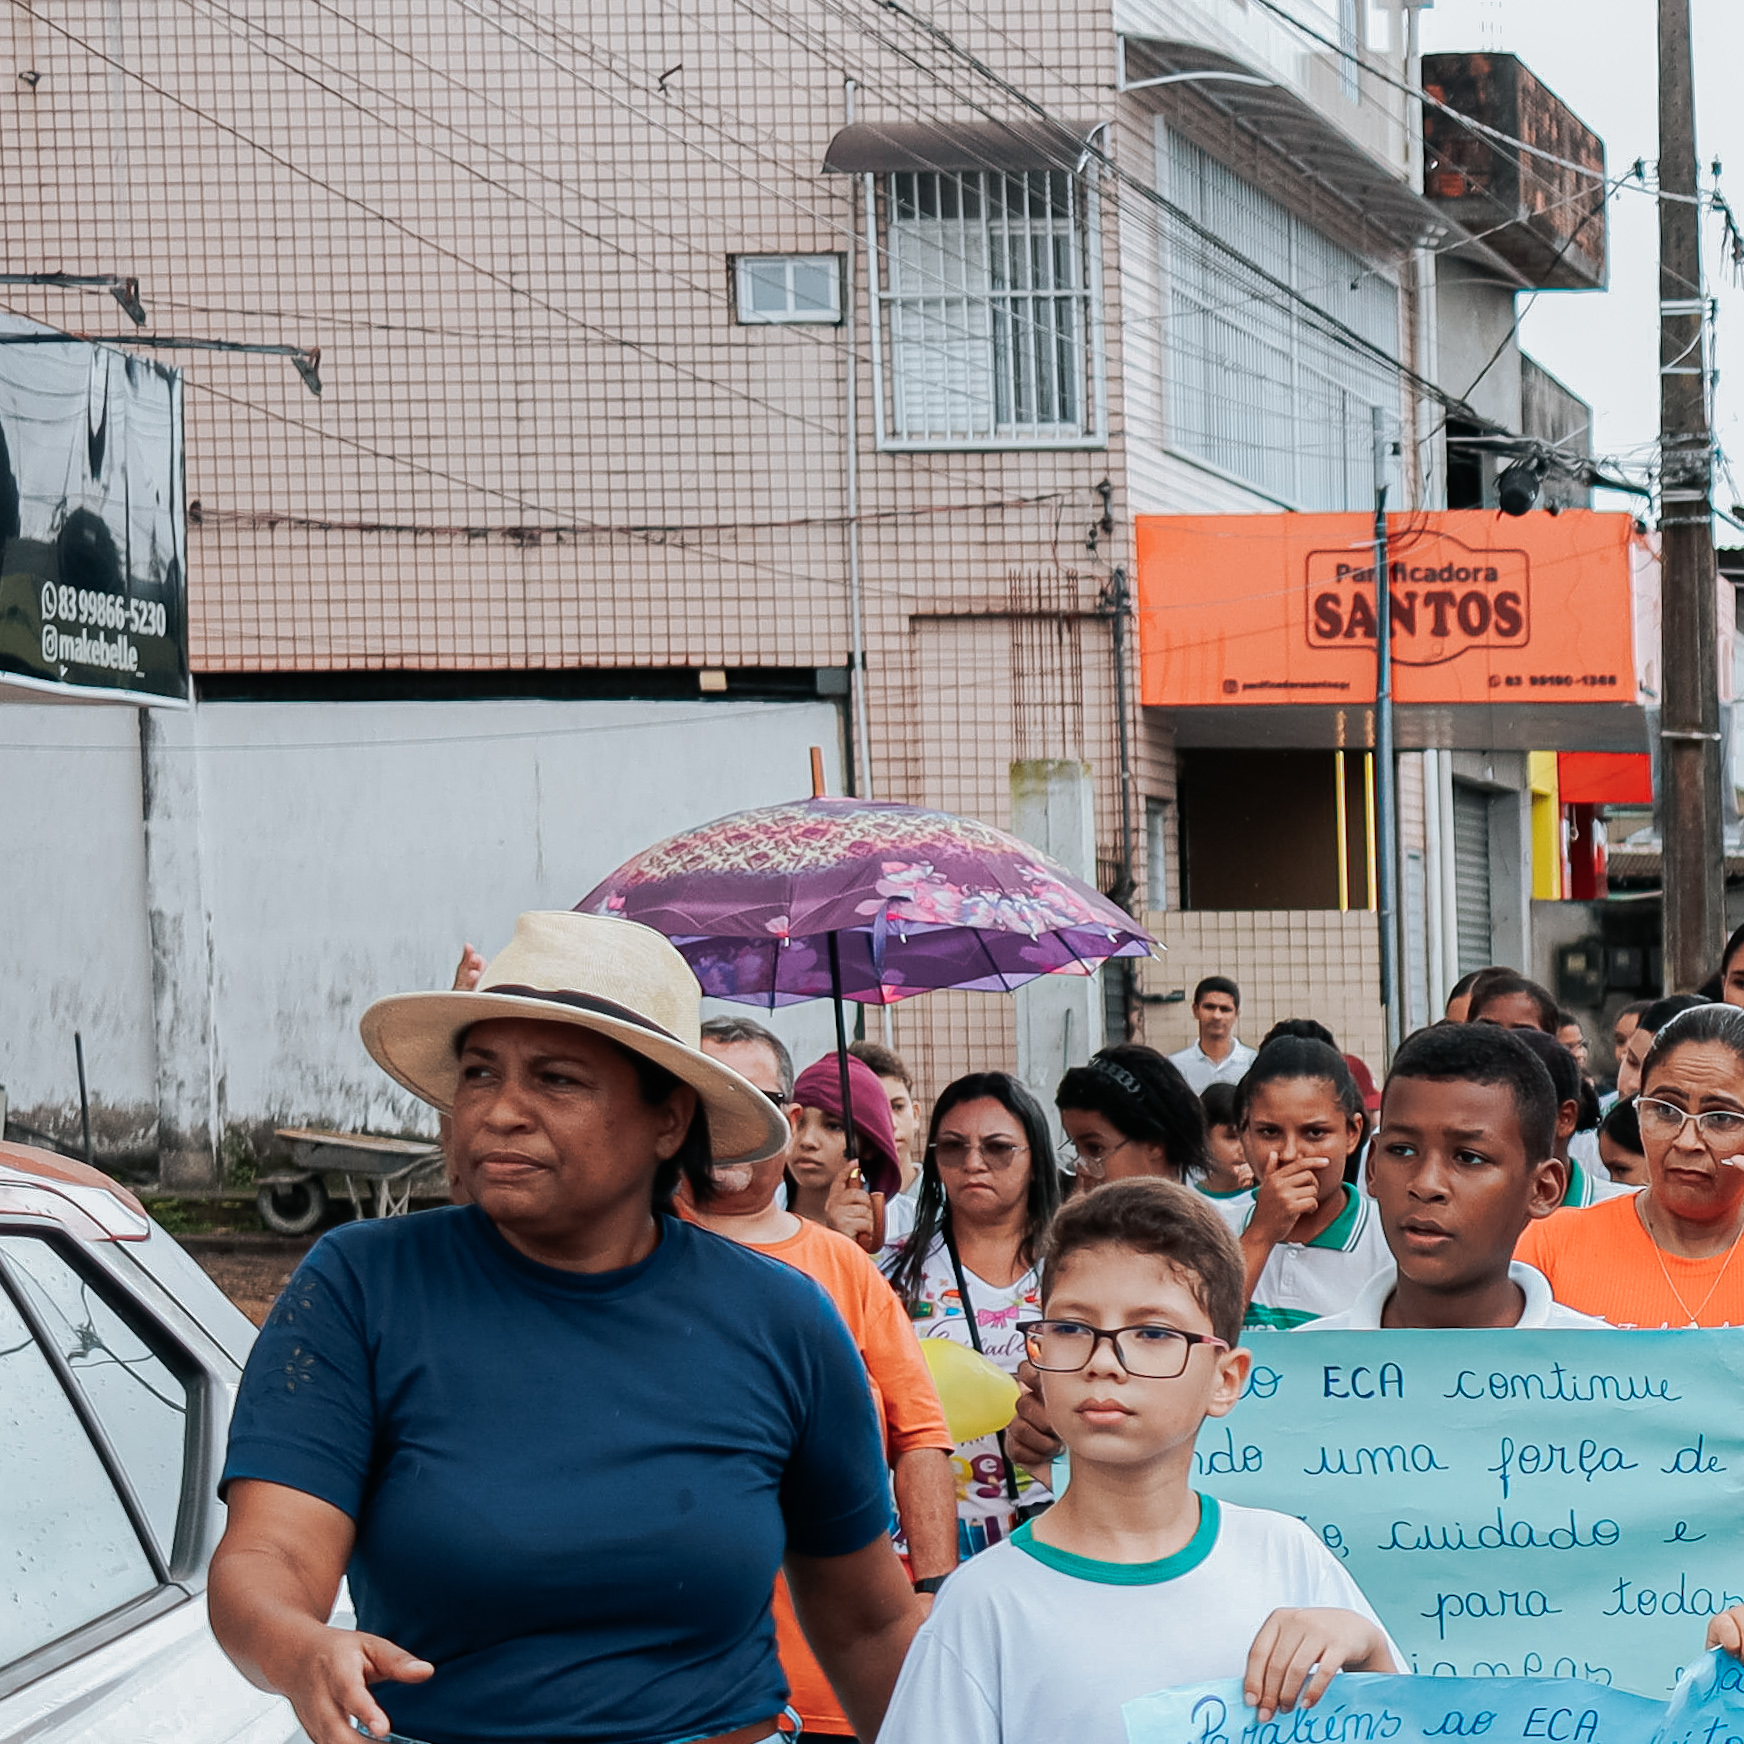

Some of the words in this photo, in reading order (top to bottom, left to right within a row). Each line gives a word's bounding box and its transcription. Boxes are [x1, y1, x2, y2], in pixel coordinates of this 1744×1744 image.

[58, 584, 77, 622] 83
[78, 588, 167, 638] 99866-5230
[1314, 590, 1523, 639] SANTOS
[1323, 1361, 1404, 1399] ECA
[1443, 1361, 1683, 1402] continue
[1303, 1443, 1450, 1475] uma
[1487, 1437, 1640, 1500] força
[1660, 1433, 1728, 1475] de
[1377, 1506, 1621, 1552] cuidado
[1662, 1520, 1707, 1543] e
[1420, 1589, 1563, 1640] para
[1423, 1708, 1497, 1738] ao
